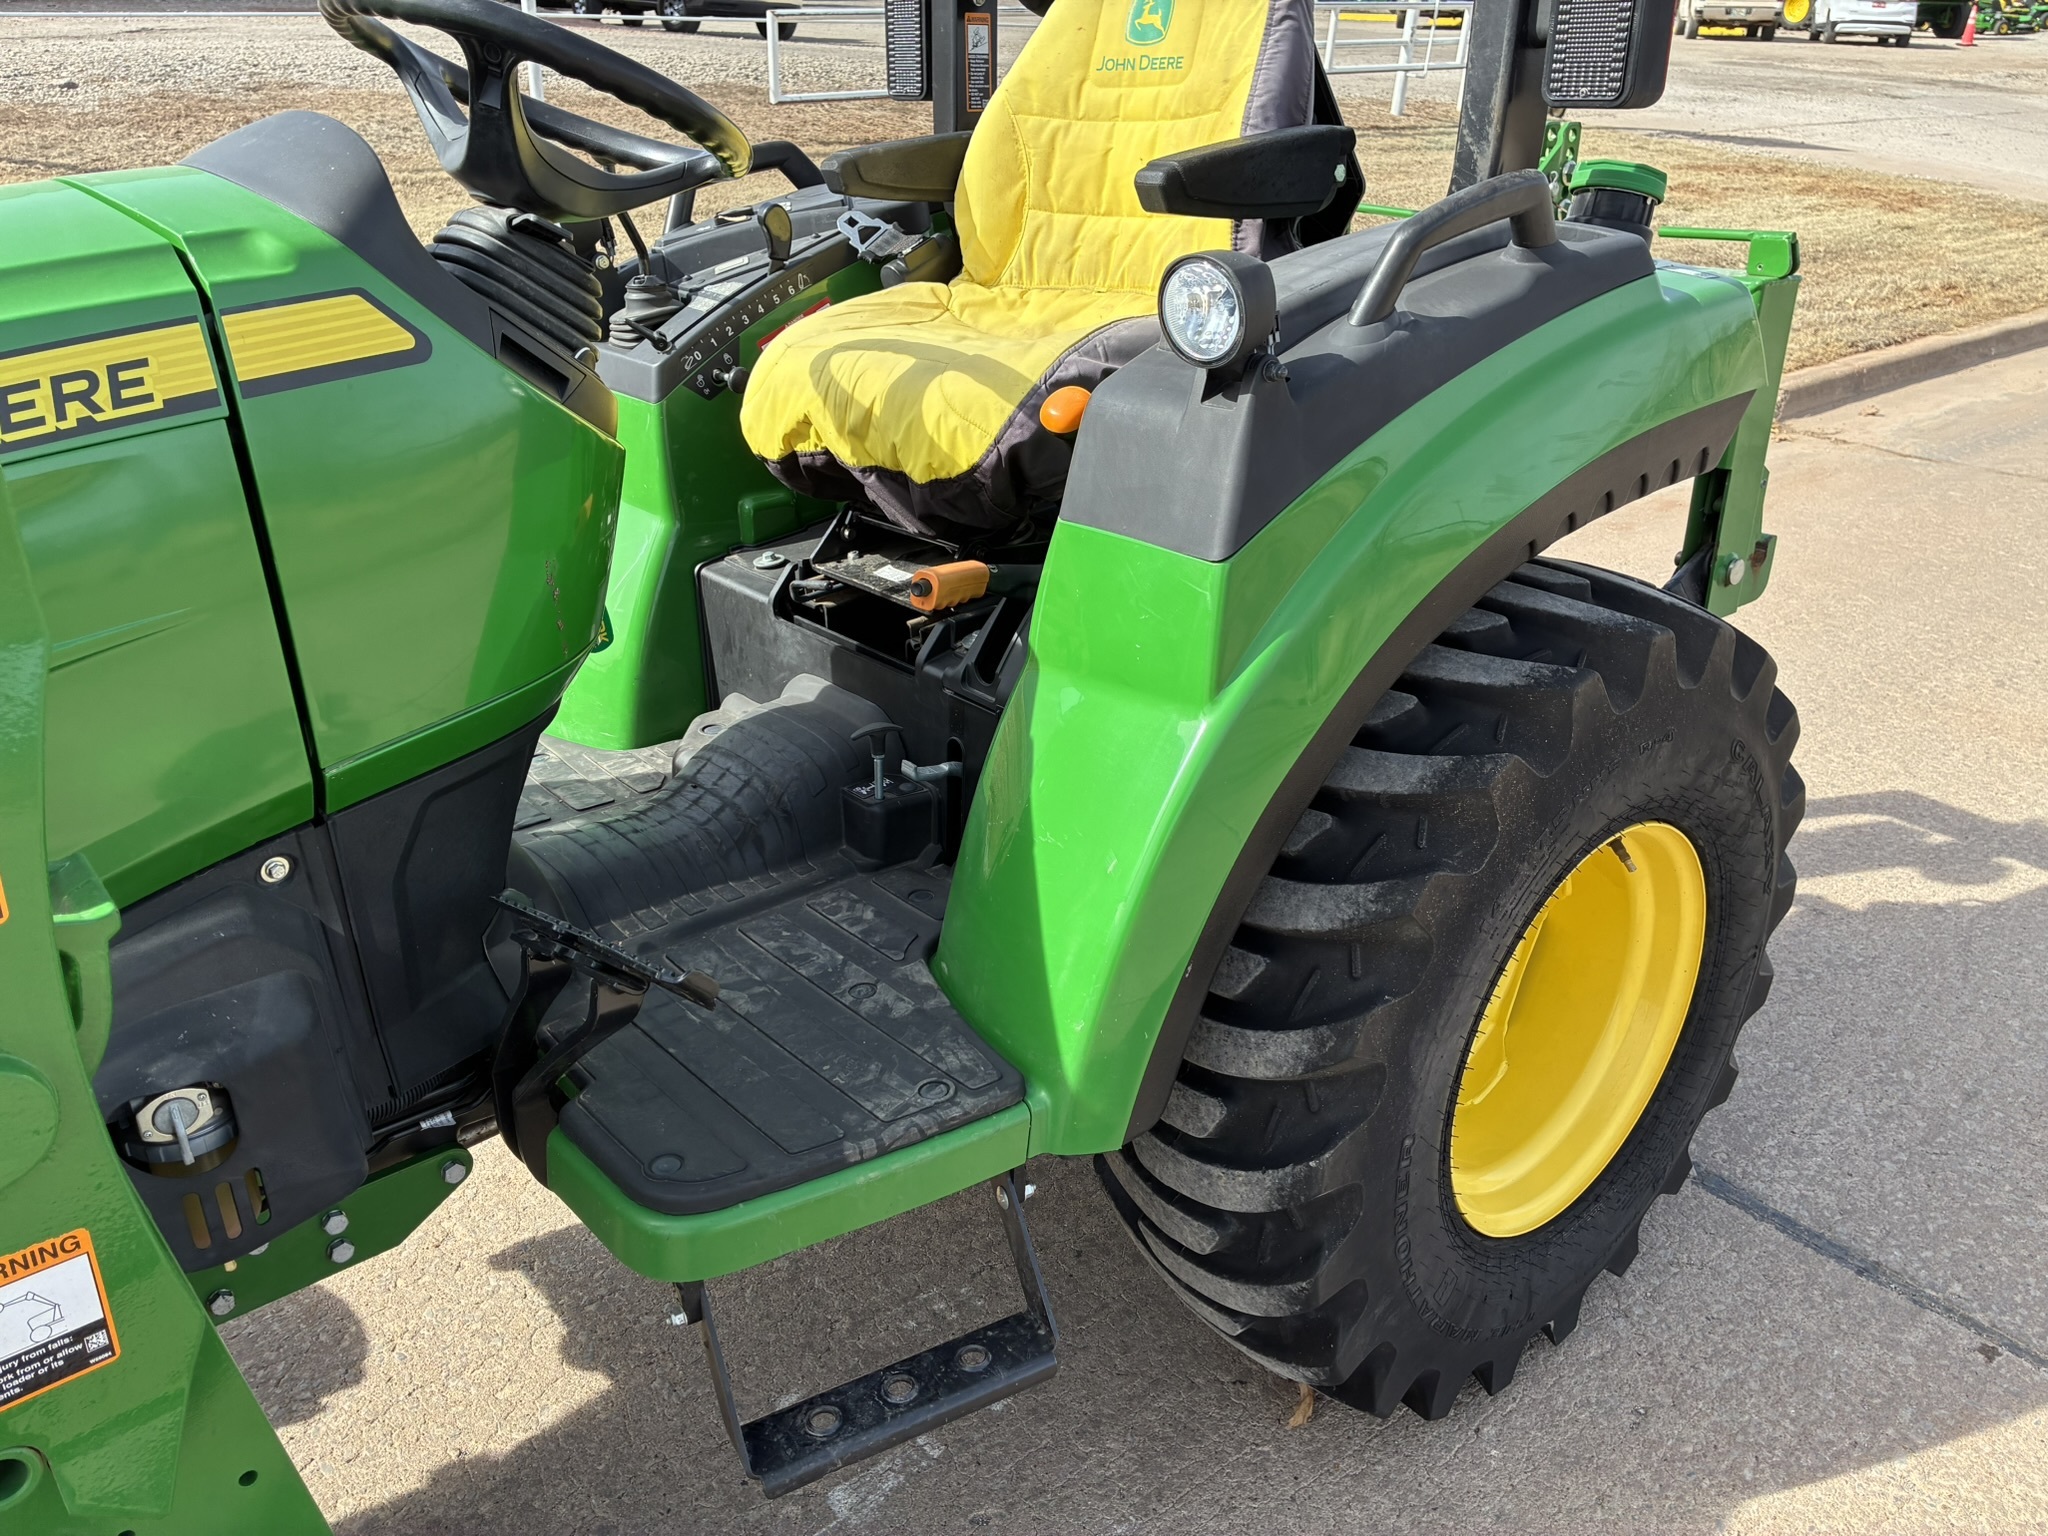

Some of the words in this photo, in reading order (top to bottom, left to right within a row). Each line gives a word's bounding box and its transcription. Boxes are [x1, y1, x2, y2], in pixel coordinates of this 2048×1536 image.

[1096, 55, 1136, 72] JOHN
[1139, 54, 1184, 71] DEERE
[710, 337, 718, 347] 1
[725, 325, 735, 337] 2
[741, 314, 750, 326] 3
[757, 303, 765, 315] 4
[772, 293, 781, 305] 5
[787, 284, 796, 296] 6
[0, 357, 155, 435] ERE
[1393, 1133, 1483, 1343] MARATHONER
[16, 1361, 41, 1375] from
[43, 1355, 54, 1364] or
[56, 1343, 83, 1358] allow
[21, 1347, 46, 1362] from
[47, 1336, 73, 1350] falls:
[2, 1372, 35, 1390] loader
[37, 1365, 49, 1375] or
